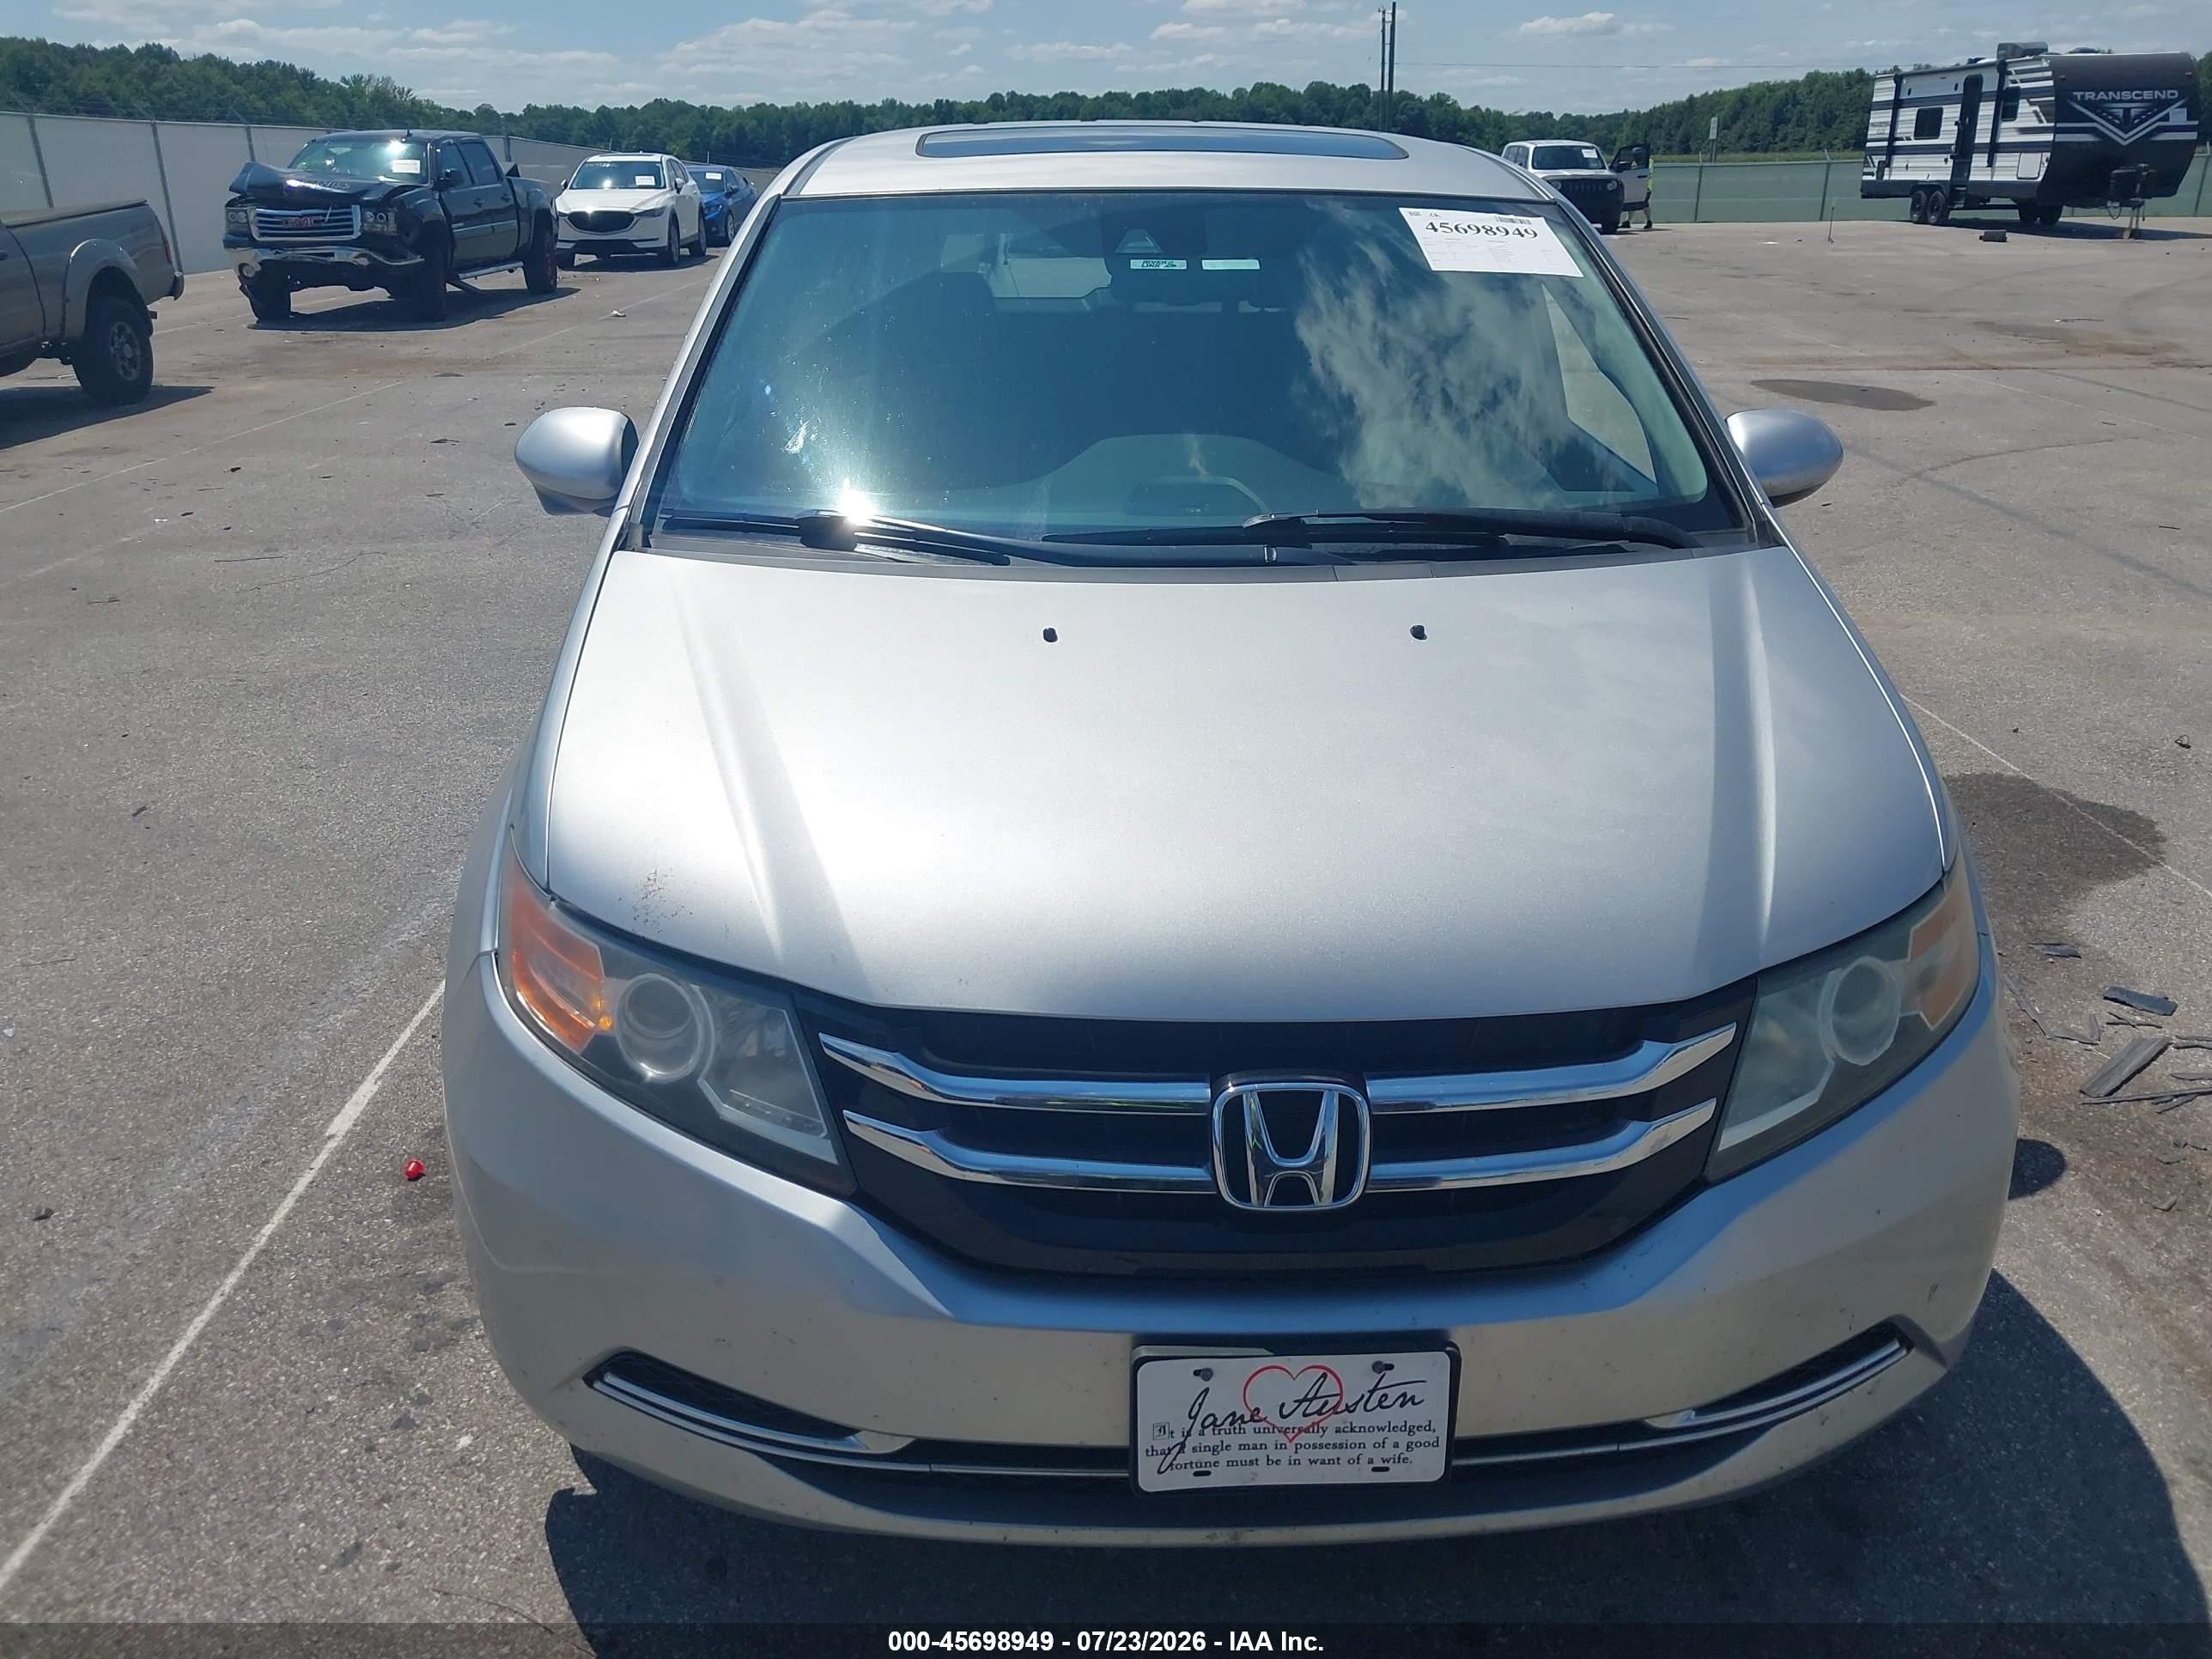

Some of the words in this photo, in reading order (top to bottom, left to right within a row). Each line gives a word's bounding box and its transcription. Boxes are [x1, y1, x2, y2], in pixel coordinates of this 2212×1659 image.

[2073, 89, 2179, 100] TRANSCEND
[1425, 221, 1538, 239] 45698949
[1154, 1424, 1175, 1439] It
[1199, 1428, 1206, 1437] a
[1212, 1423, 1246, 1436] truth
[1254, 1421, 1328, 1437] universally
[1334, 1419, 1436, 1437] acknowledged,
[1157, 1387, 1267, 1475] Jane
[1279, 1372, 1428, 1419] Austen
[1192, 1440, 1231, 1456] single
[1238, 1443, 1267, 1451] man
[1274, 1440, 1287, 1450] in
[1294, 1439, 1366, 1454] possession
[1373, 1437, 1389, 1449] of
[1406, 1436, 1439, 1452] good
[1226, 1457, 1260, 1467] must
[1267, 1455, 1282, 1466] be
[1288, 1455, 1301, 1466] in
[1309, 1456, 1341, 1465] want
[1347, 1453, 1364, 1465] of
[1381, 1452, 1413, 1464] wife.
